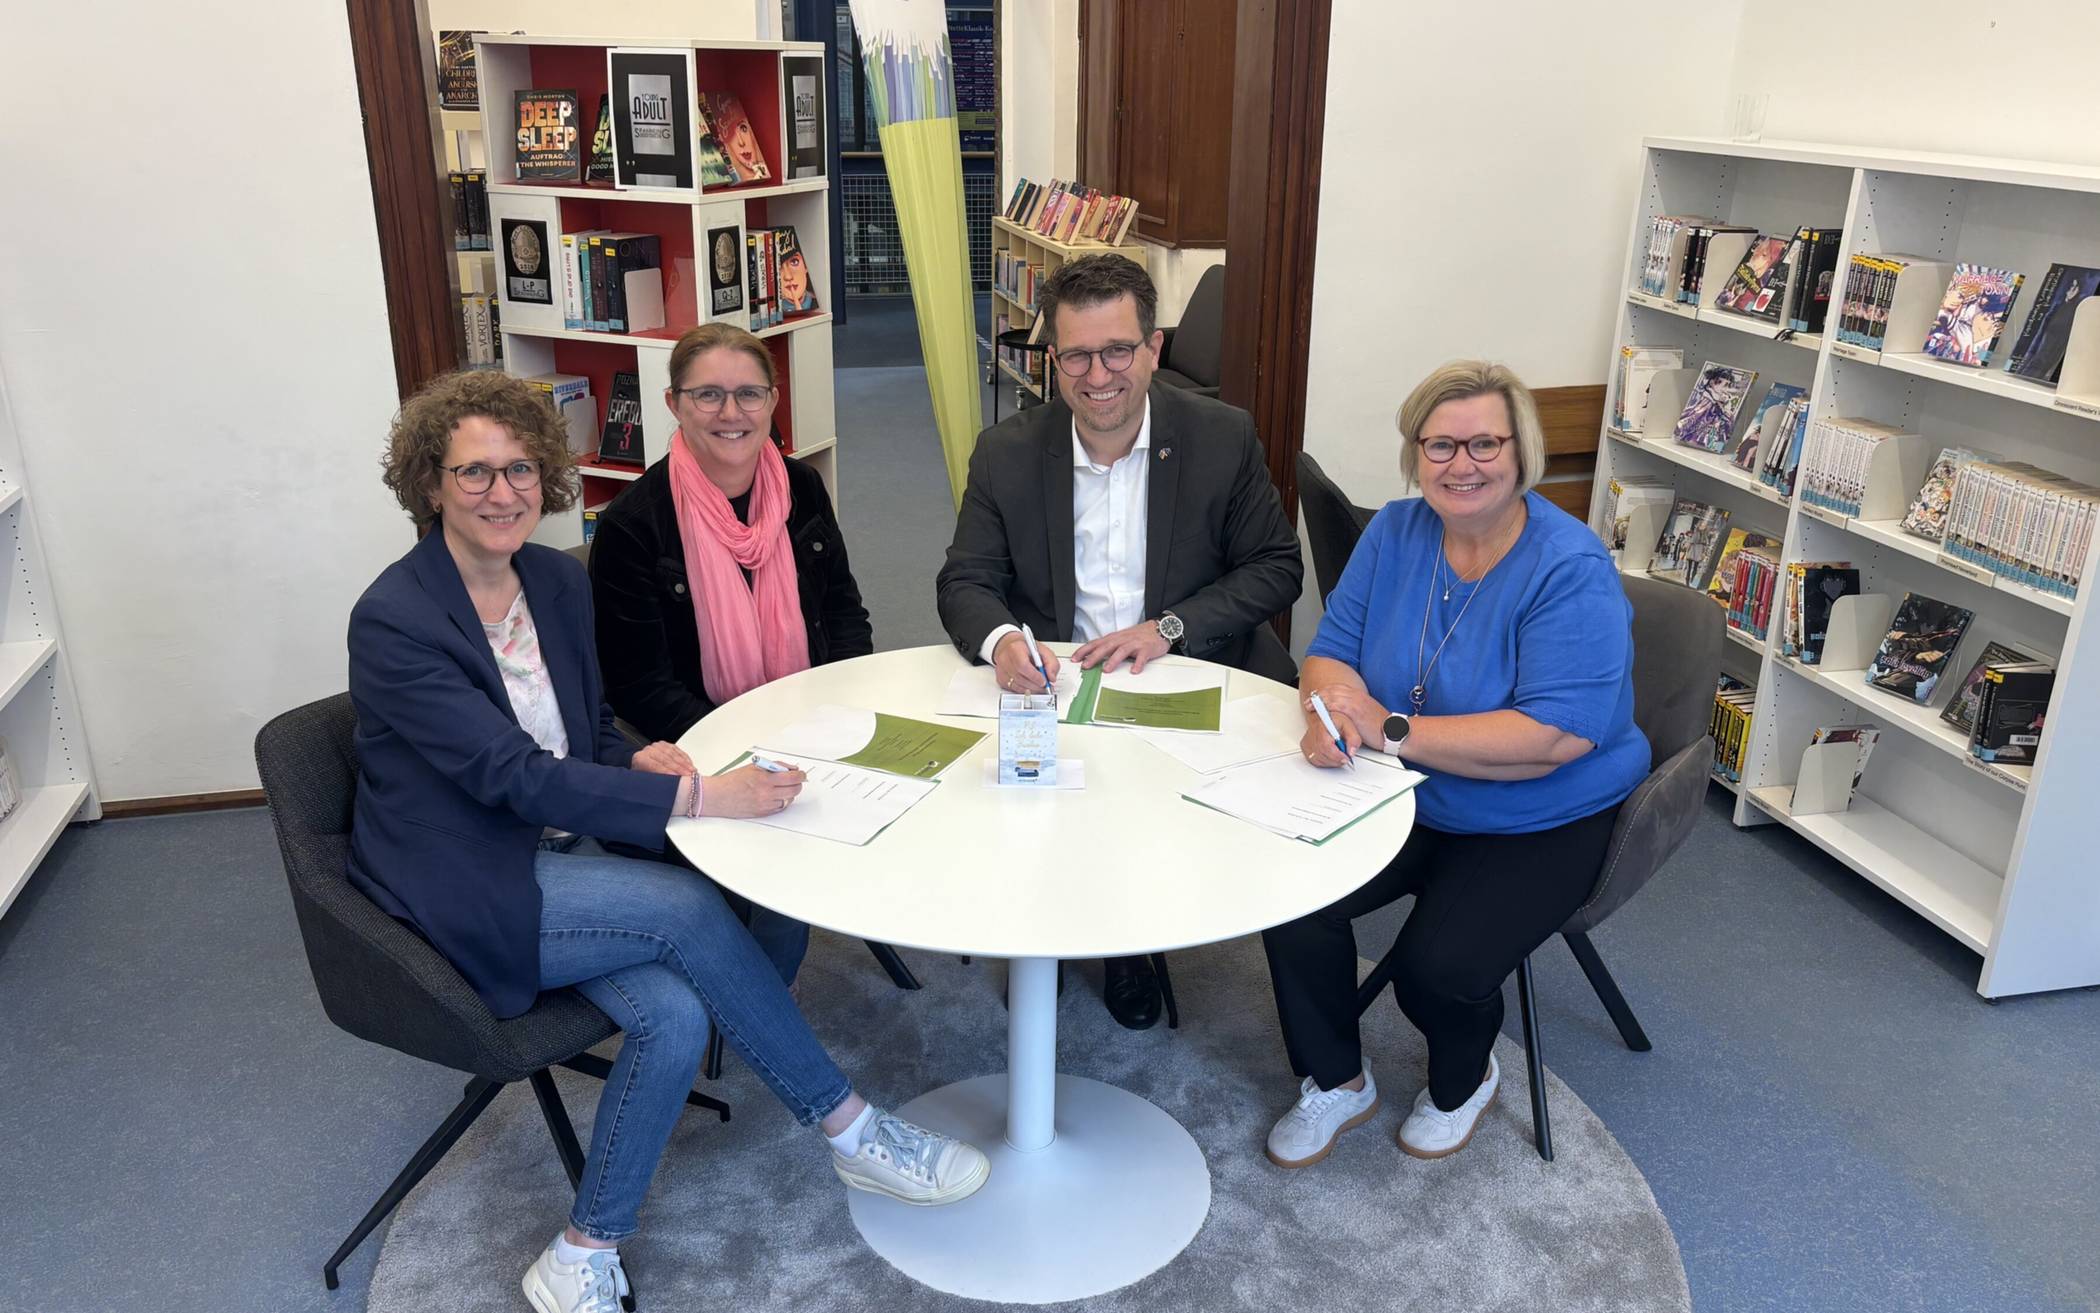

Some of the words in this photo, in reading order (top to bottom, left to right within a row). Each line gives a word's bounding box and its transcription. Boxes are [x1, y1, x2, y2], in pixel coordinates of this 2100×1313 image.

[520, 101, 572, 127] DEEP
[632, 96, 667, 120] ADULT
[517, 126, 577, 152] SLEEP
[535, 160, 576, 168] WHISPERER
[476, 307, 487, 347] VORTEX
[608, 399, 641, 426] EREBO
[620, 423, 633, 450] 3
